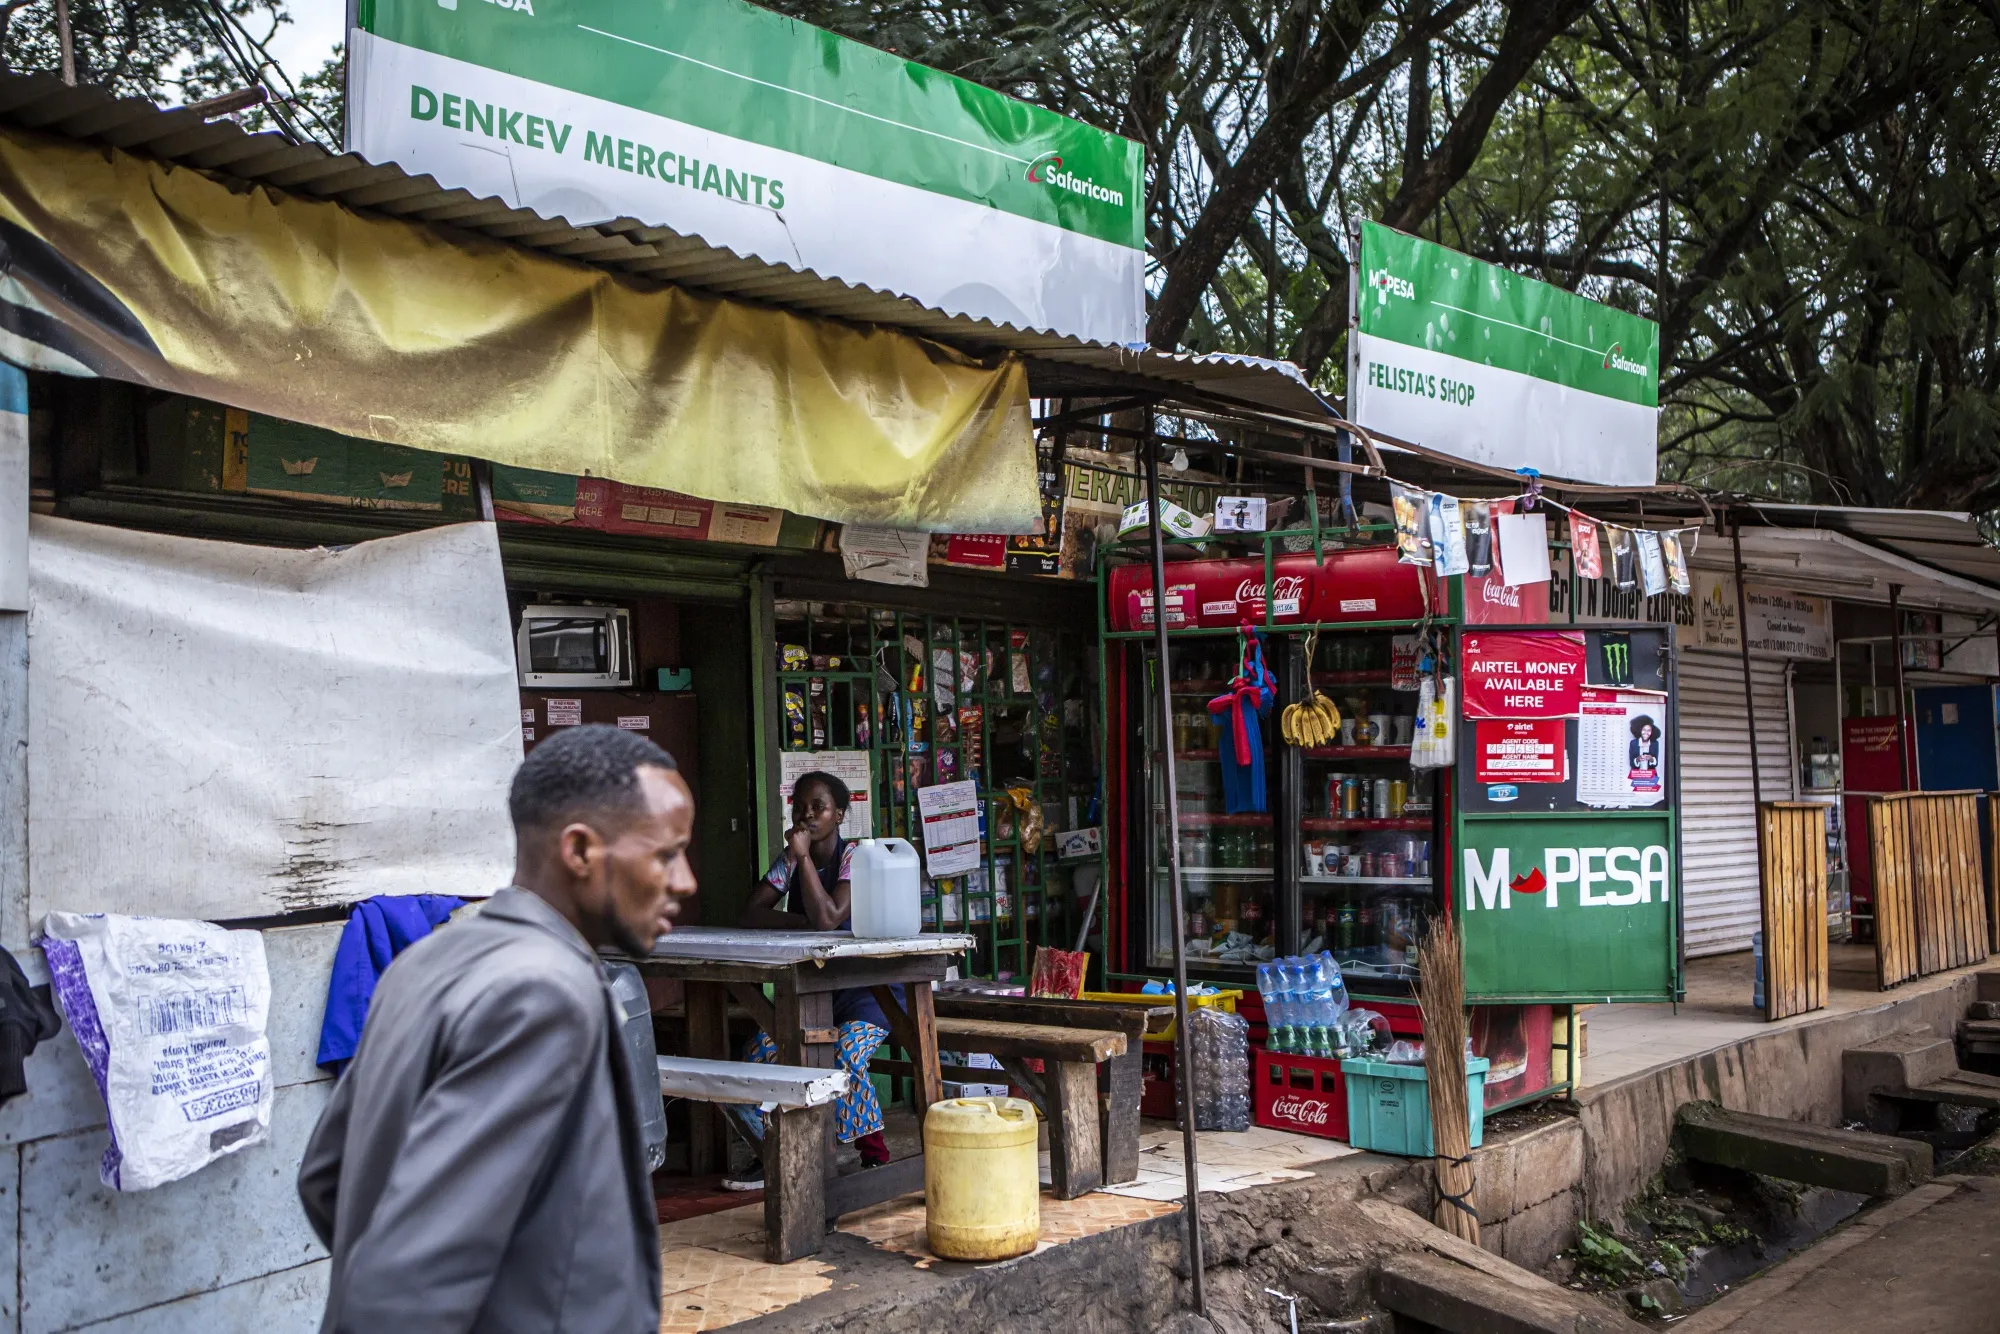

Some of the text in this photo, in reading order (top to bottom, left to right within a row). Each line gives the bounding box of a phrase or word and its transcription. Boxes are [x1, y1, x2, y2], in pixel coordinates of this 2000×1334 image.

[410, 85, 785, 210] DENKEV MERCHANTS
[1046, 159, 1124, 206] Safaricom
[1612, 353, 1647, 377] Safaricom
[1368, 362, 1475, 407] FELISTA'S SHOP
[579, 506, 603, 517] HERE
[1471, 661, 1577, 675] AIRTEL MONEY
[1484, 678, 1564, 691] AVAILABLE
[1504, 696, 1544, 708] HERE
[1515, 723, 1533, 731] airtel
[162, 1043, 189, 1058] Kenya
[1272, 1095, 1330, 1125] Coca-Cola
